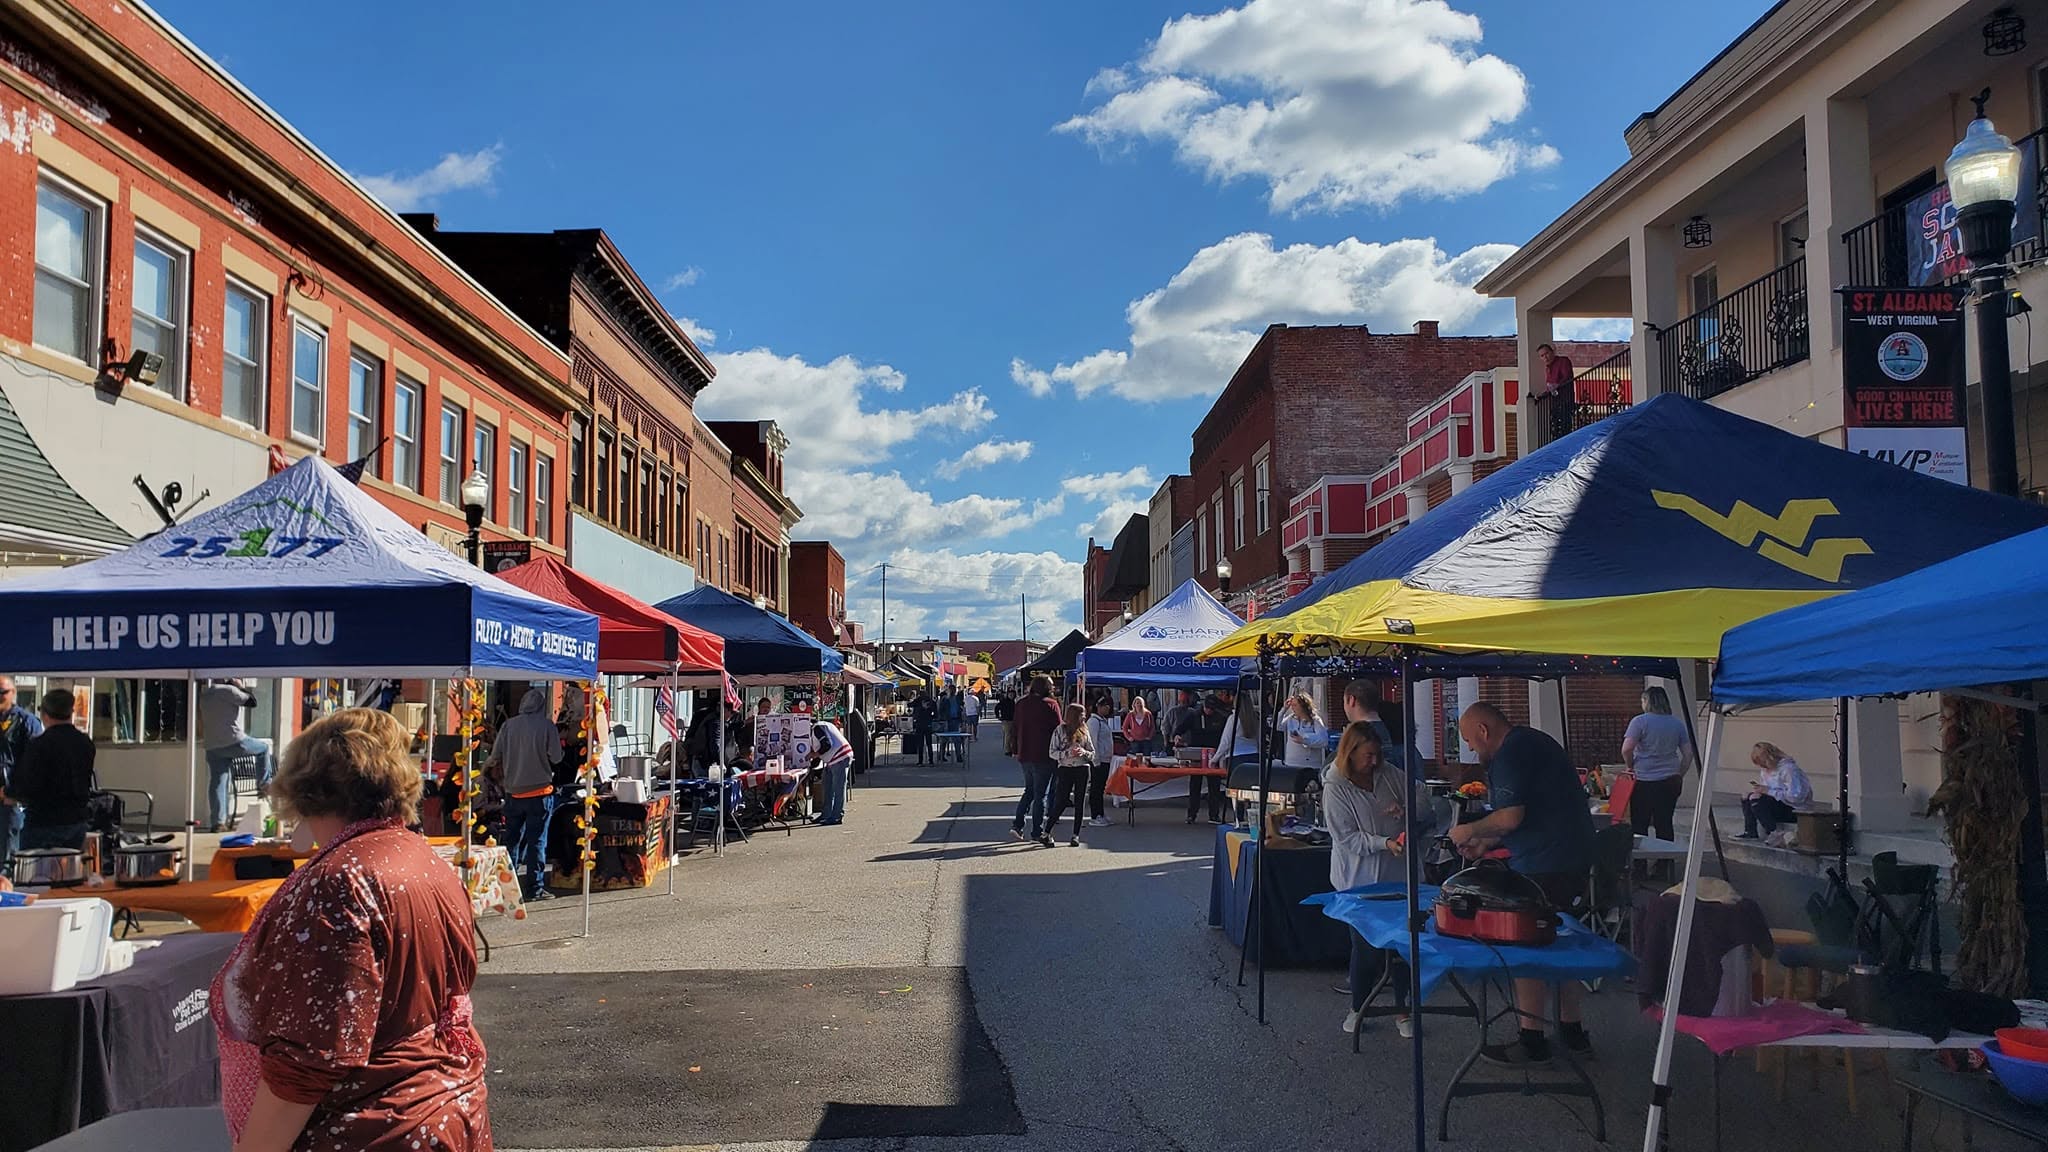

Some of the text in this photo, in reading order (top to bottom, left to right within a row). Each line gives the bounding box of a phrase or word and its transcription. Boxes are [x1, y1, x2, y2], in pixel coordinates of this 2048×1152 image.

[1853, 292, 1954, 312] ST. ALBANS
[1867, 315, 1939, 326] WEST VIRGINIA
[1856, 391, 1954, 402] GOOD CHARACTER
[1856, 402, 1954, 420] LIVES HERE
[159, 527, 346, 559] 25177
[52, 611, 335, 651] HELP US HELP YOU
[476, 618, 596, 662] AUTO HOME BUSINESS LIFE
